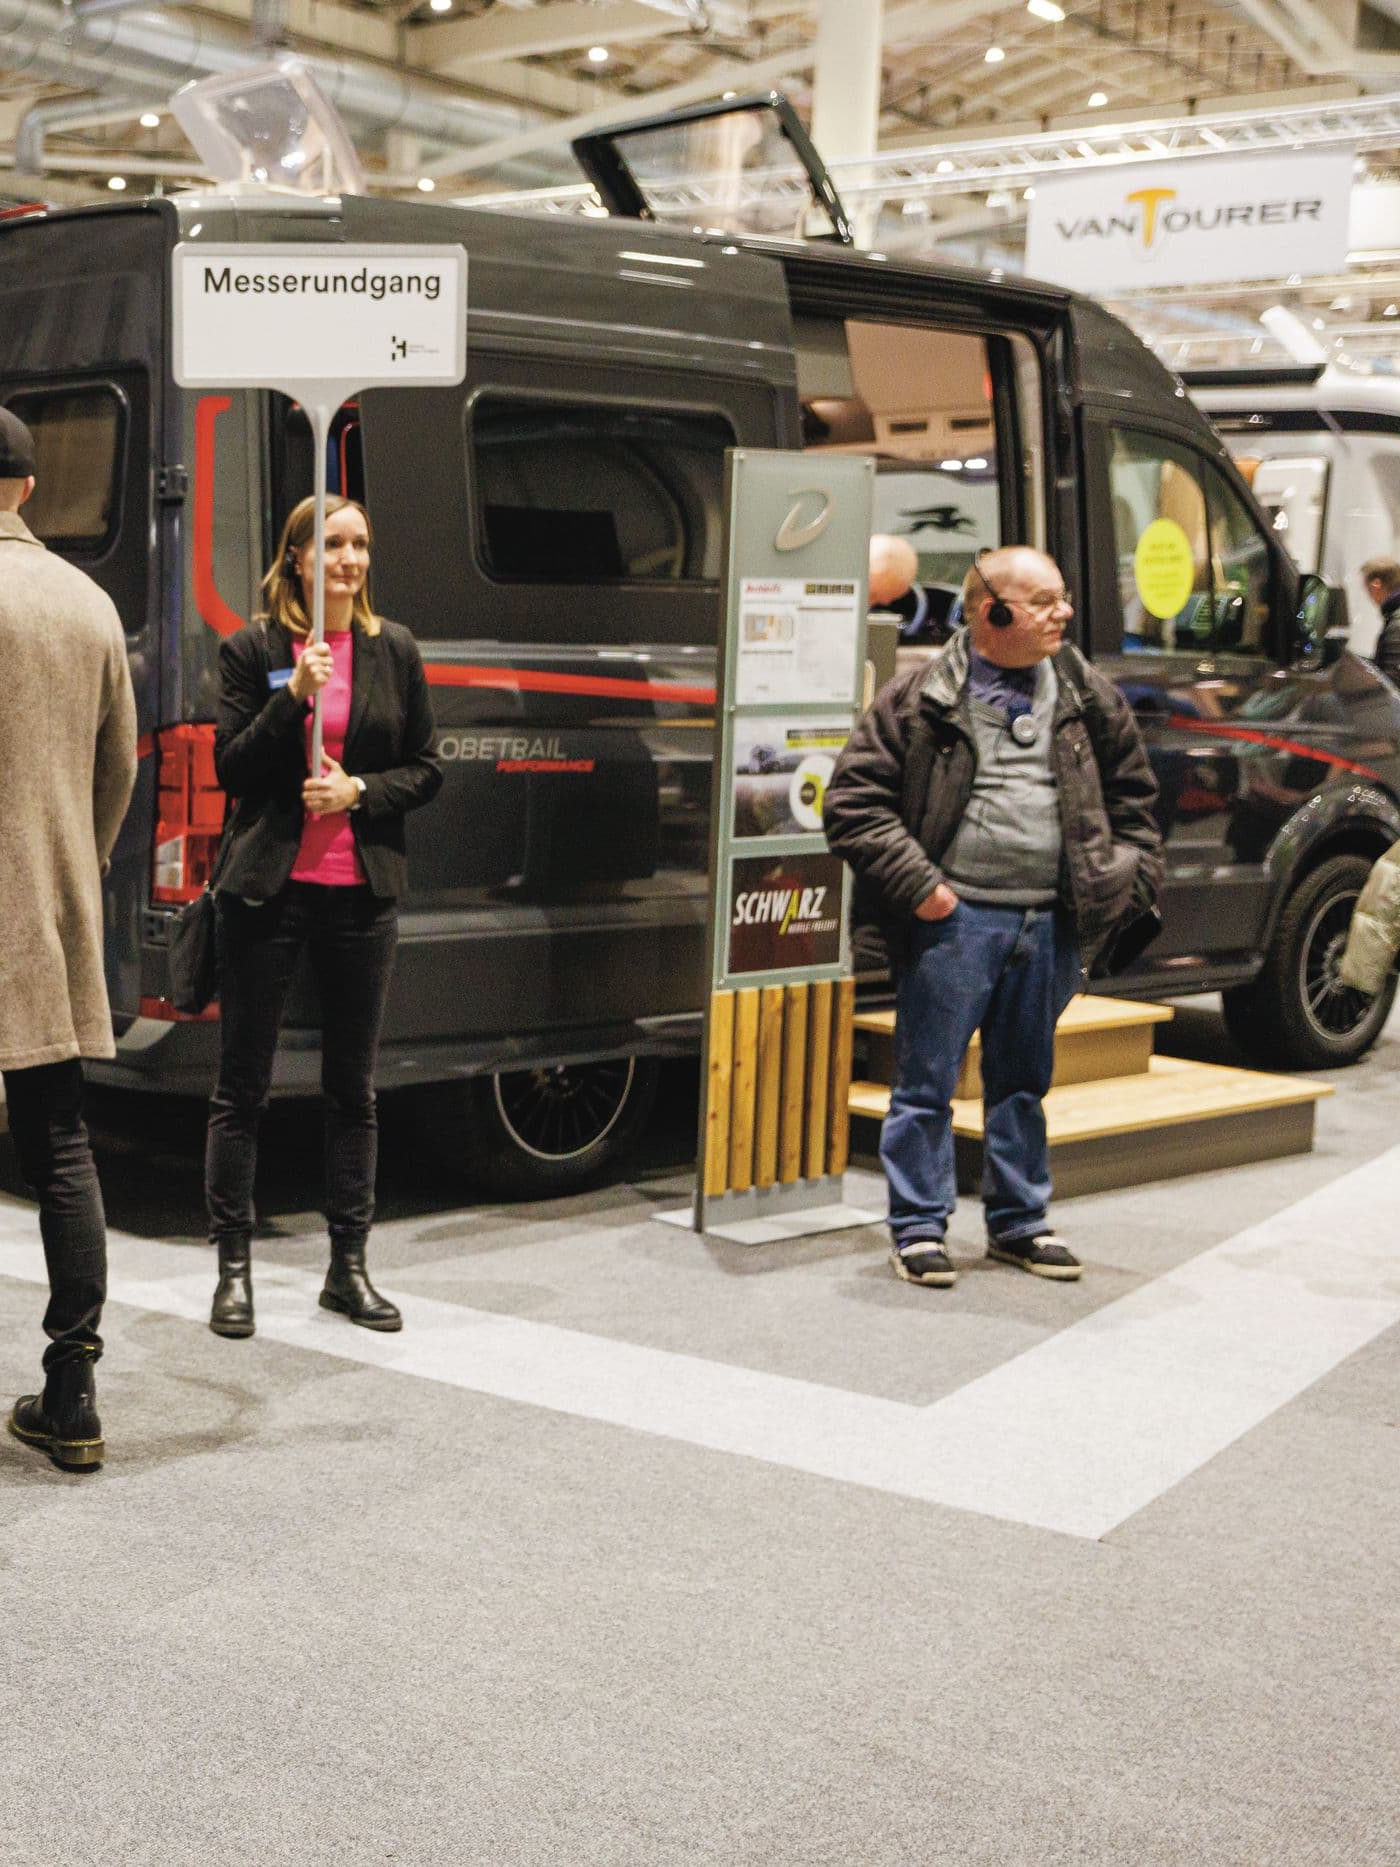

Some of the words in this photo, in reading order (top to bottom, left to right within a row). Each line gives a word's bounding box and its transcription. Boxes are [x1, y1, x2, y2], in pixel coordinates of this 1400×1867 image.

[1055, 187, 1324, 249] VANTOURER
[204, 267, 441, 300] Messerundgang
[732, 885, 828, 936] SCHWARZ
